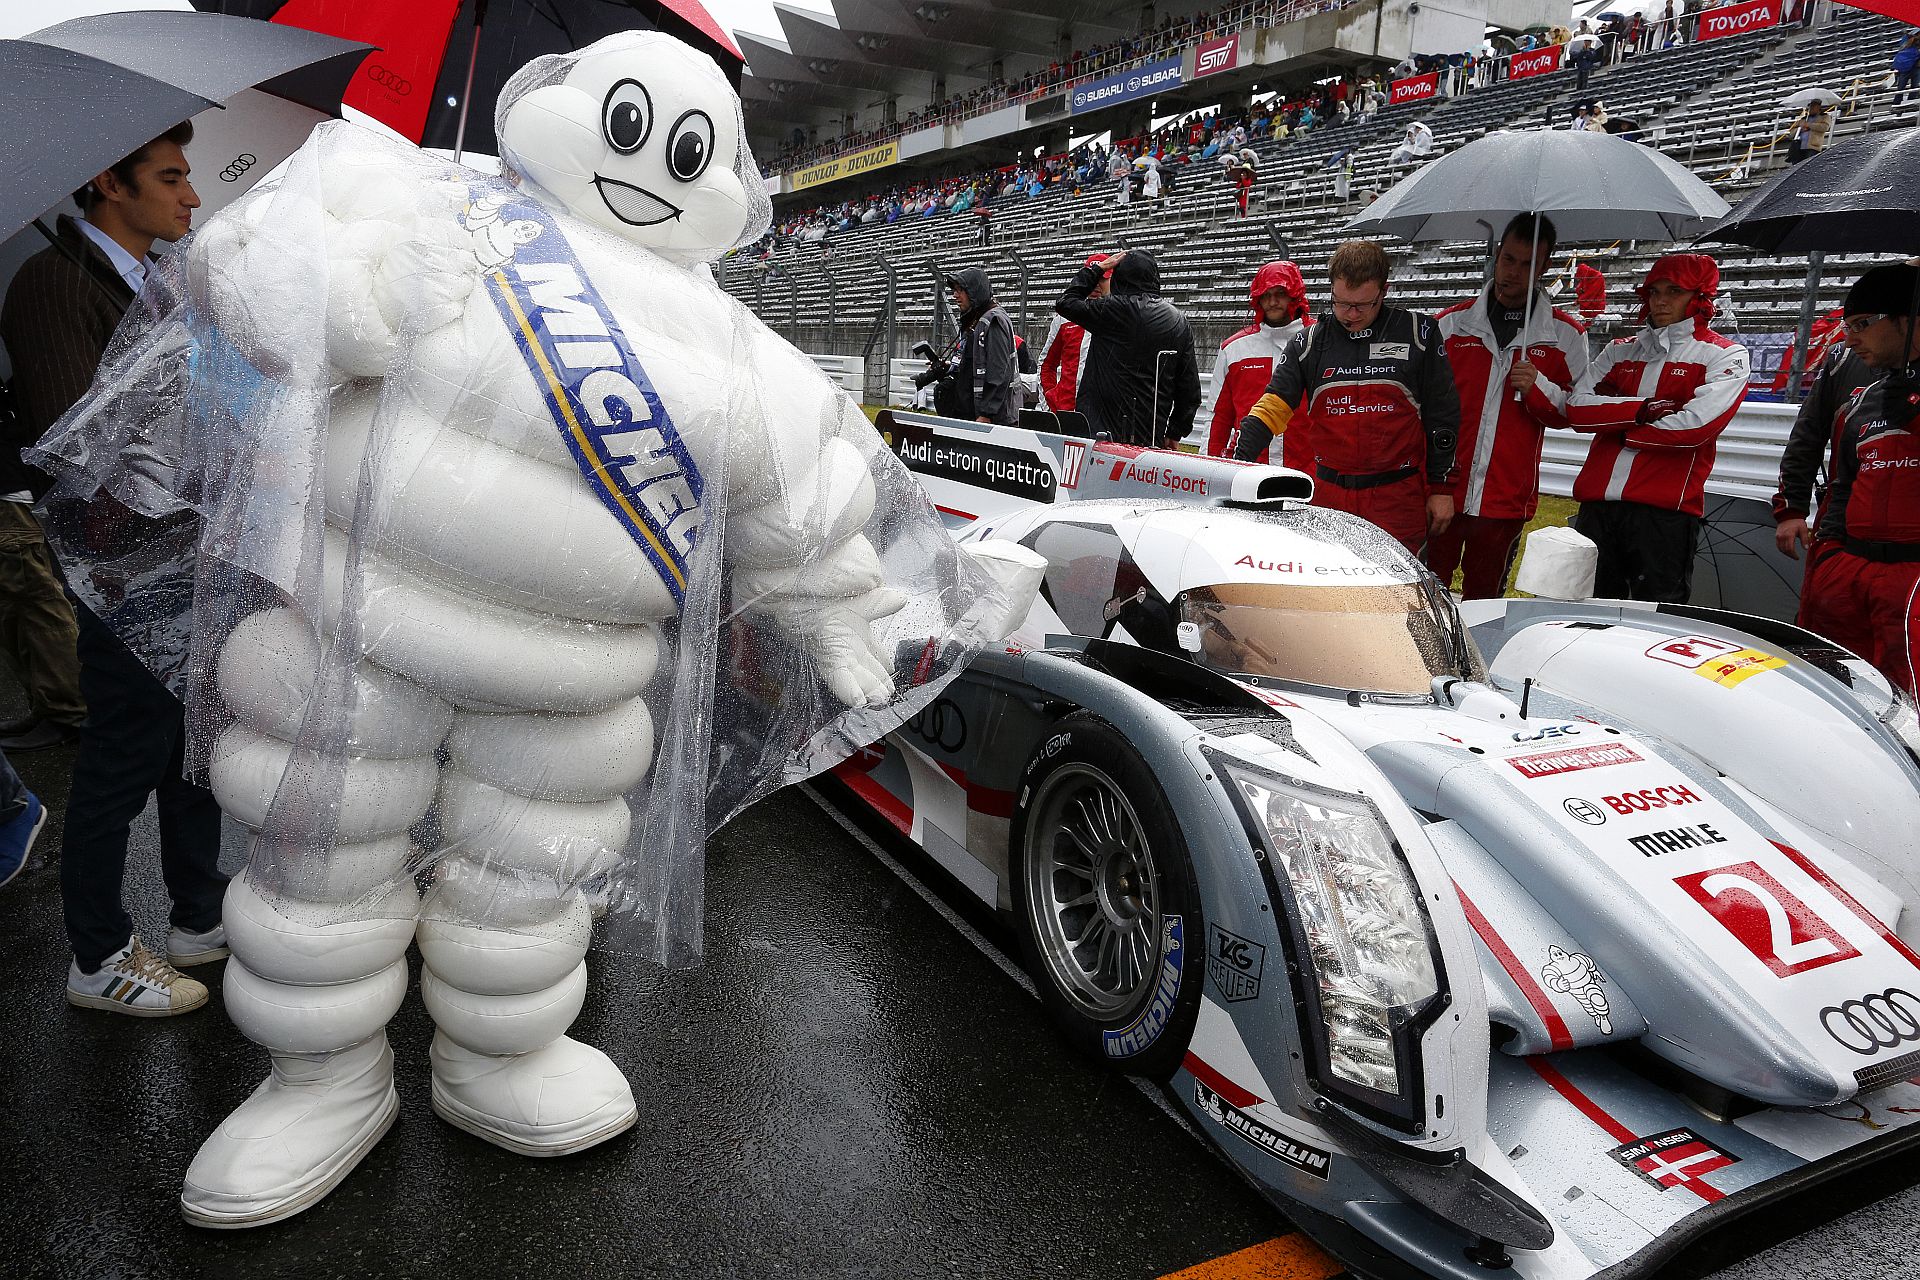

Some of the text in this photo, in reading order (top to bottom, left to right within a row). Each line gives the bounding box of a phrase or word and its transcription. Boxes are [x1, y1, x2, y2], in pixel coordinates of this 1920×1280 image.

[1708, 7, 1771, 32] TOYOTA
[1513, 54, 1552, 75] TOYOTA
[1087, 66, 1183, 102] SUBARU SUBARU
[1395, 81, 1432, 99] TOYOTA
[801, 147, 893, 185] DUNLOP DUNLOP
[1336, 365, 1396, 375] Audi Sport
[1326, 396, 1351, 405] Audi
[1326, 403, 1394, 416] Top Service
[900, 437, 1051, 488] Audi e-tron quattro
[1060, 444, 1085, 486] HY
[1872, 456, 1920, 470] Servic
[1126, 463, 1207, 496] Audi Sport
[1234, 554, 1303, 574] Audi
[1314, 565, 1388, 577] e-tron
[1661, 638, 1727, 660] P1
[1517, 748, 1630, 774] fiawec.com
[1601, 784, 1703, 815] BOSCH
[1627, 823, 1728, 858] MAHLE
[1699, 872, 1841, 968] 2
[1218, 932, 1254, 970] TAG
[1211, 961, 1256, 998] HEUER
[1107, 959, 1180, 1056] MICHELIN
[1226, 1110, 1328, 1169] MICHELIN
[1620, 1132, 1693, 1161] SIMNSEN
